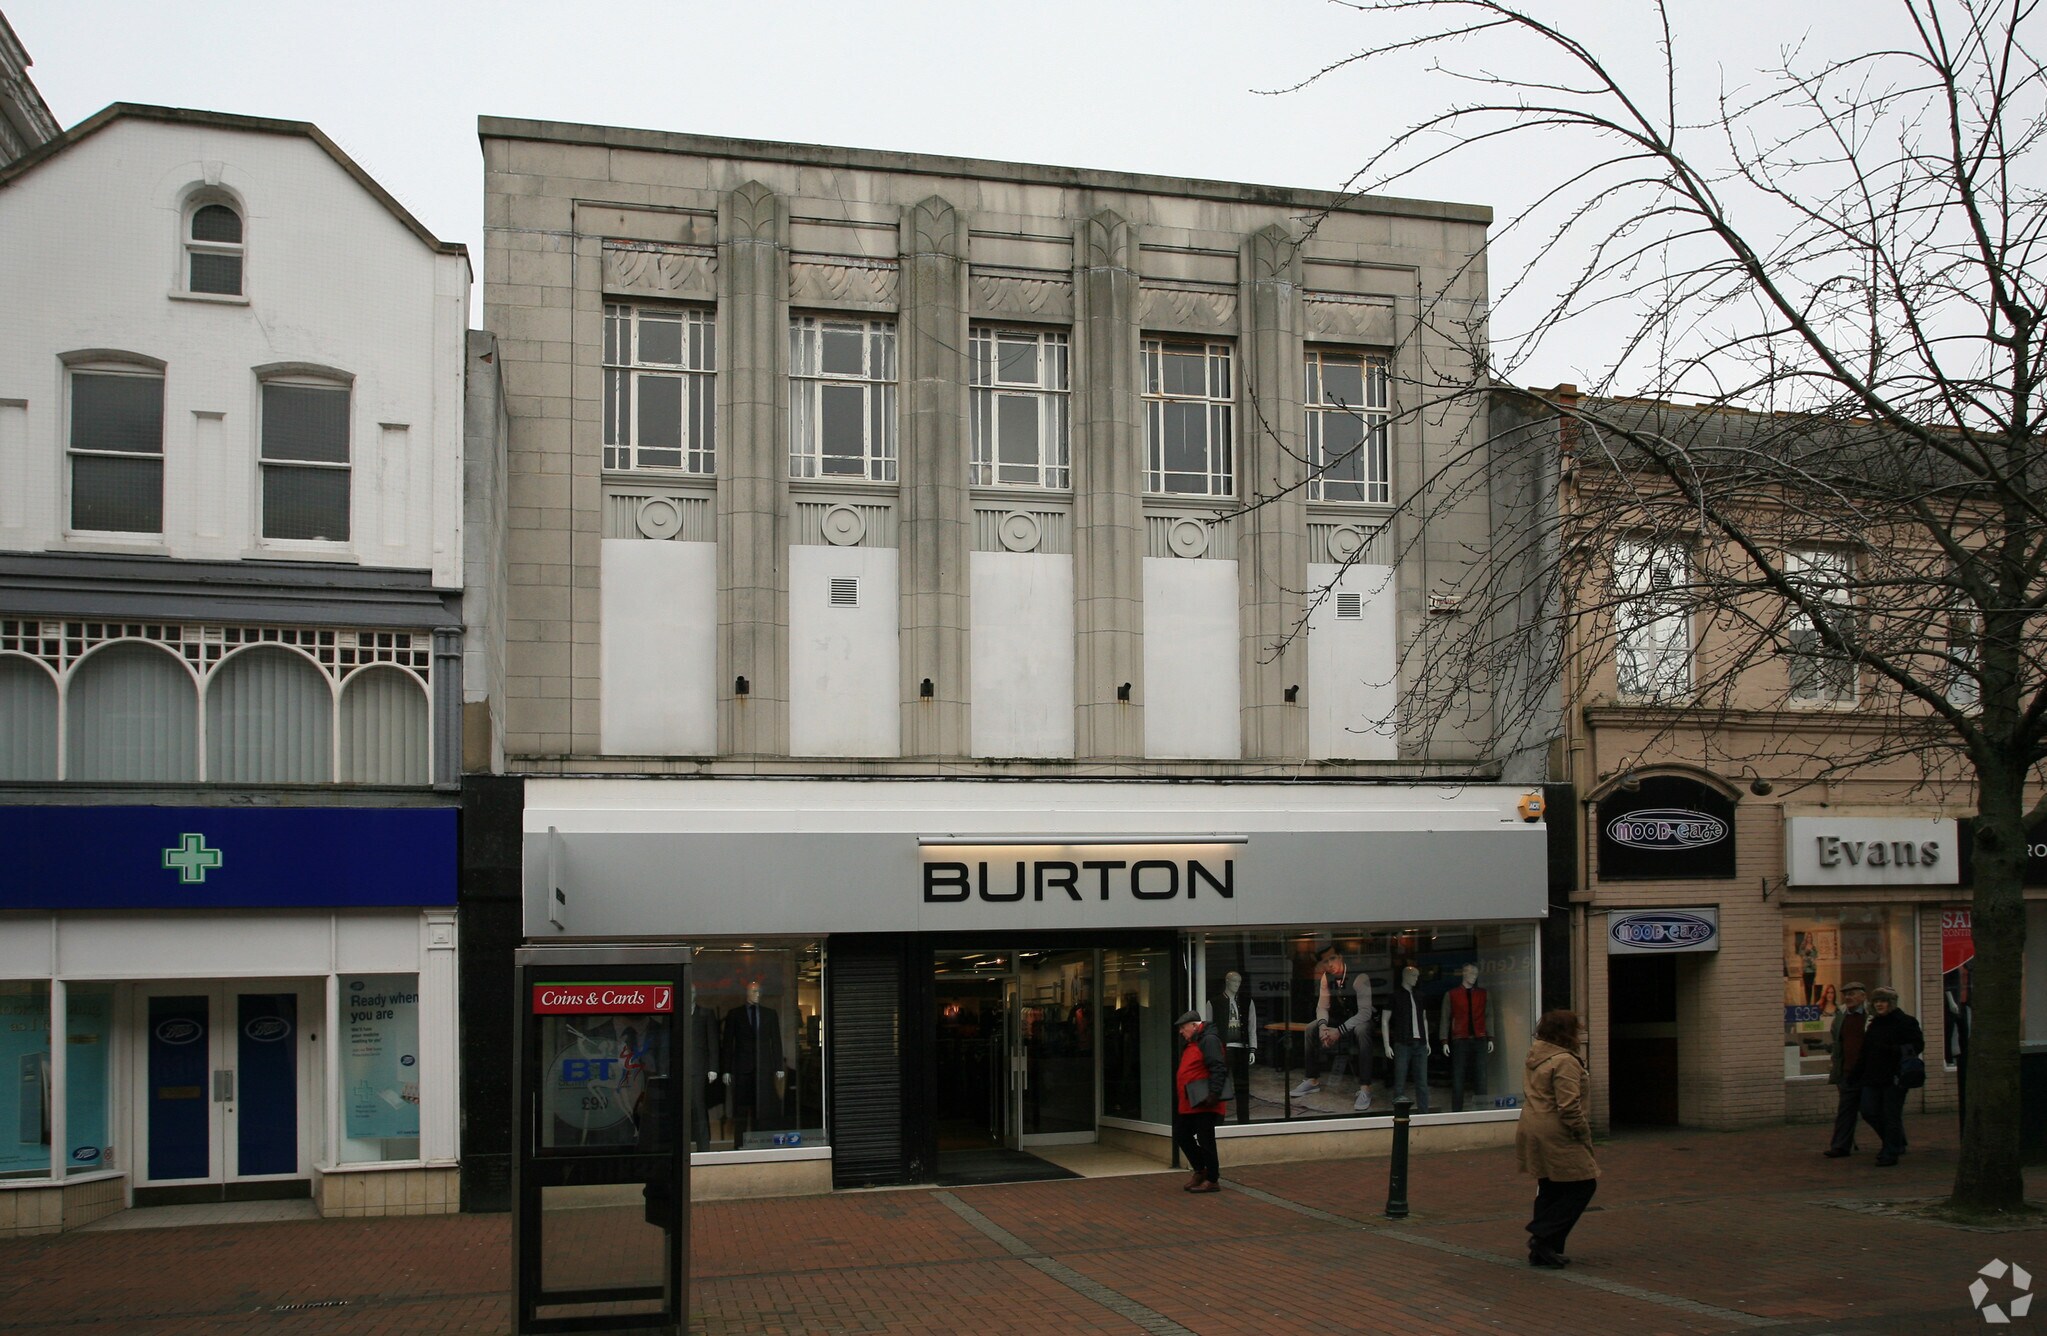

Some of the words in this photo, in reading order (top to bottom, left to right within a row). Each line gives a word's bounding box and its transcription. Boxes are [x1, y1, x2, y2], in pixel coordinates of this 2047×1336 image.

[1817, 835, 1940, 867] Evans
[924, 860, 1234, 902] BURTON
[351, 993, 386, 1008] Ready
[389, 991, 419, 1005] when
[541, 990, 584, 1006] Coins
[585, 992, 599, 1006] &
[601, 990, 645, 1005] Cards
[350, 1011, 373, 1024] you
[375, 1010, 394, 1020] are
[1795, 1007, 1819, 1021] £35
[563, 1058, 619, 1082] BT
